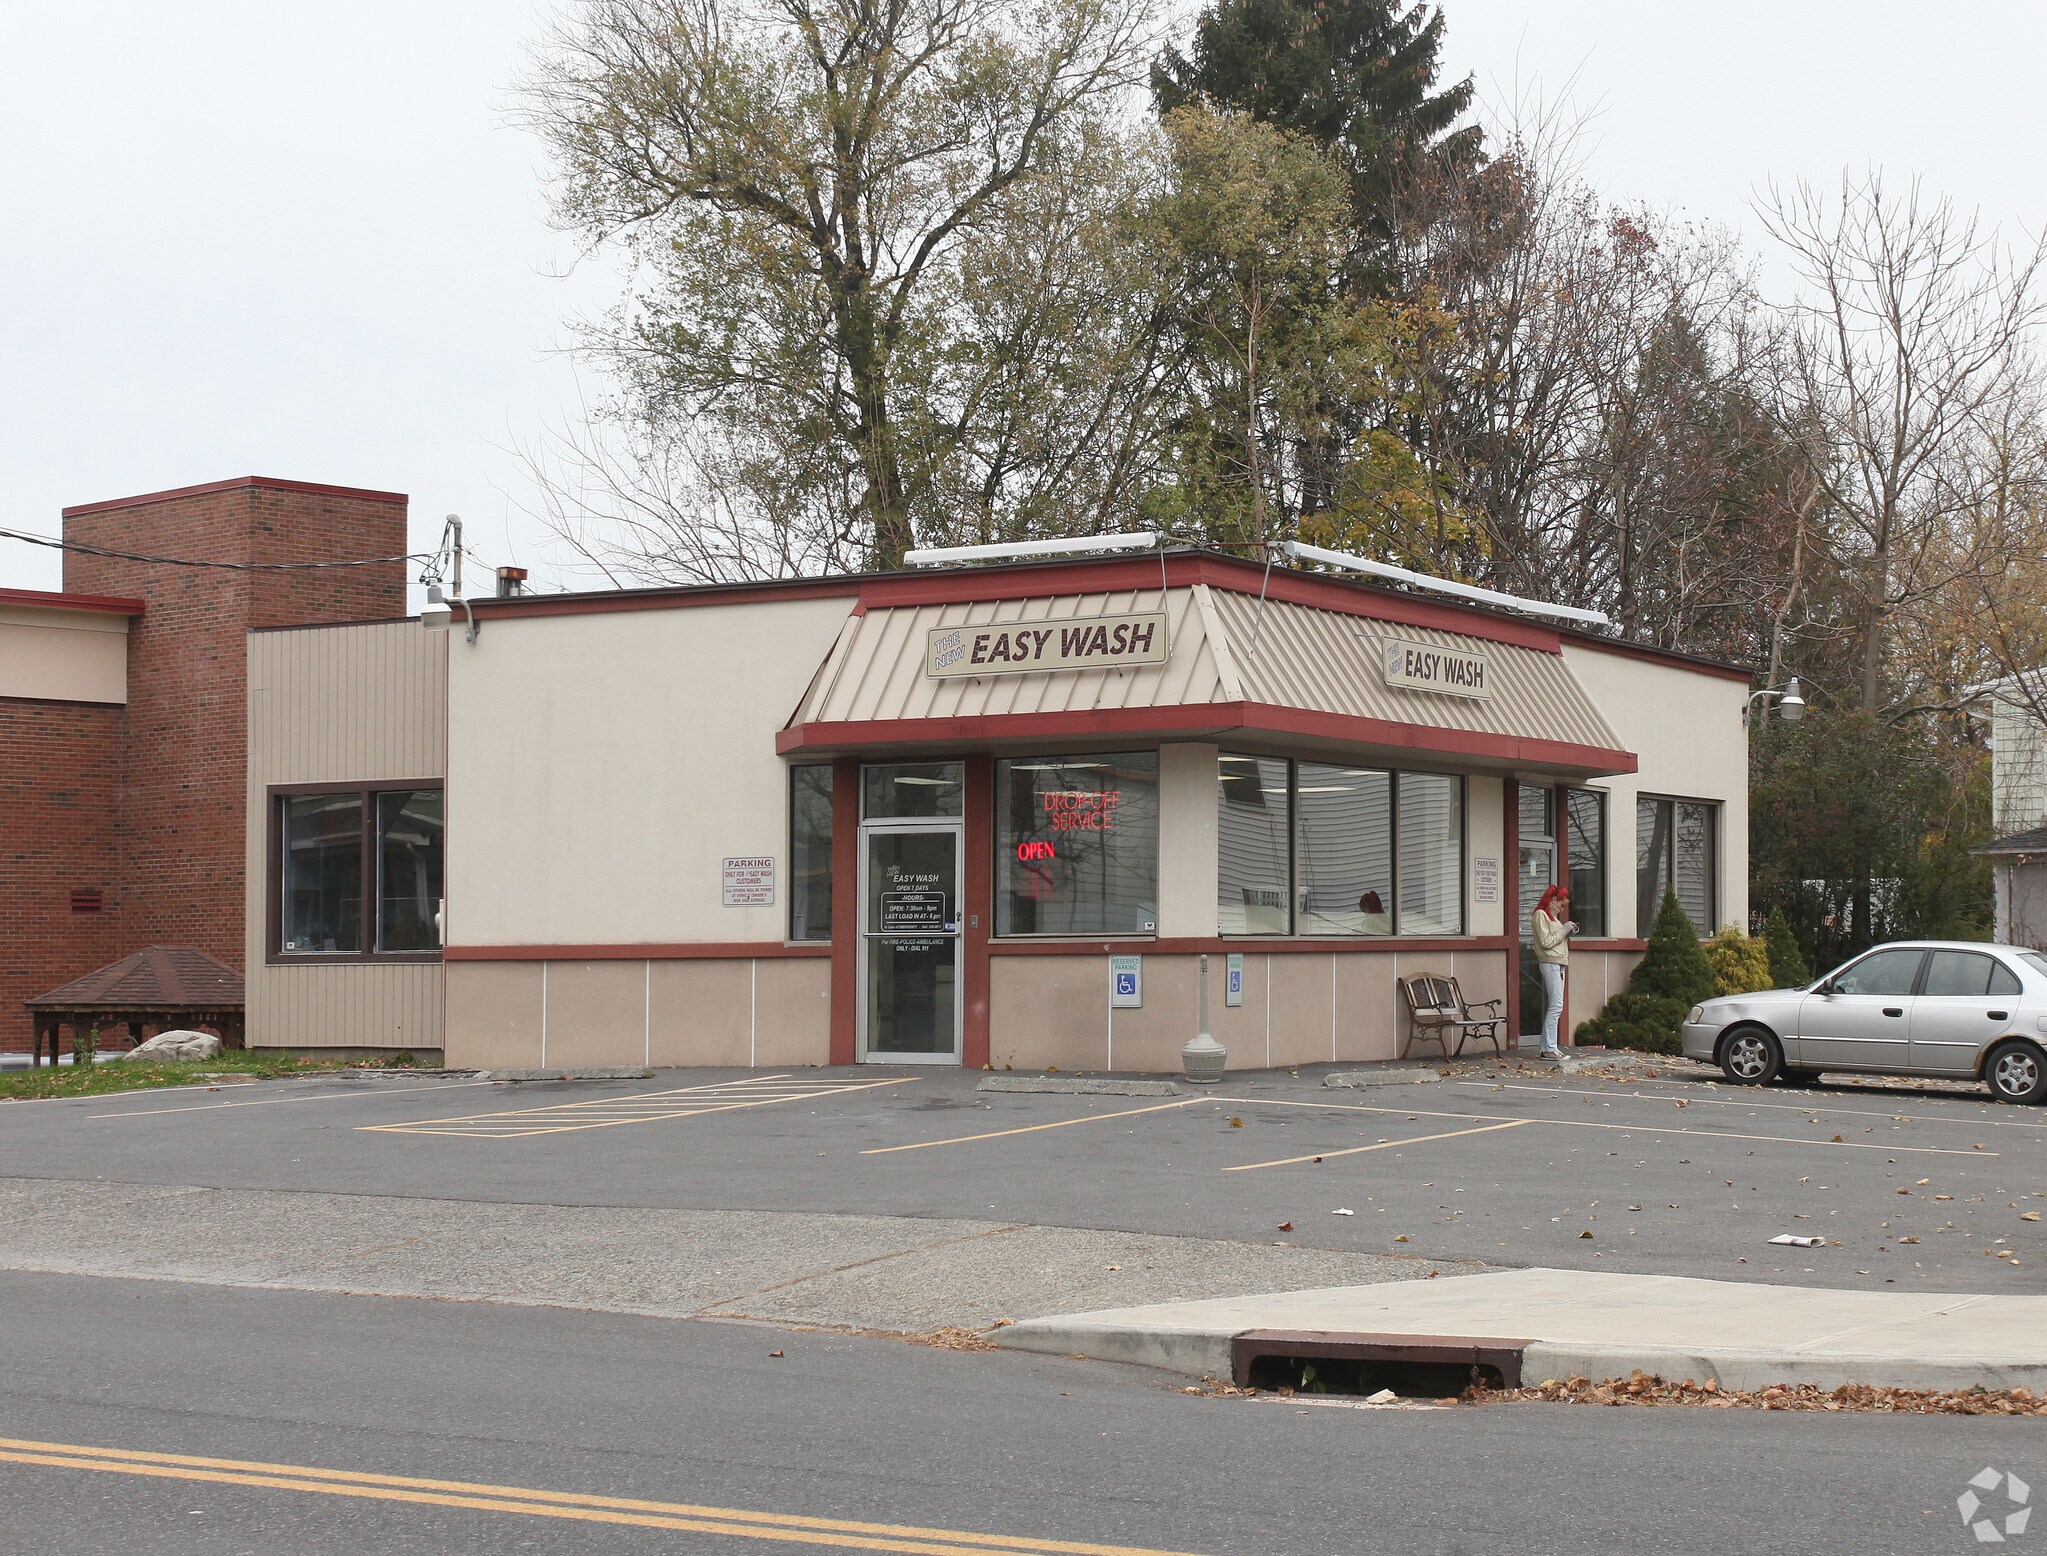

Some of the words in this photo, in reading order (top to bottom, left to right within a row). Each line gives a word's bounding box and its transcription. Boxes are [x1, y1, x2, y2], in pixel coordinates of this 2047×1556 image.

[934, 631, 961, 653] THE
[970, 629, 1054, 665] EASY
[1061, 622, 1155, 657] WASH
[935, 645, 966, 670] NEW
[1405, 649, 1441, 681] EASY
[1444, 656, 1483, 688] WASH
[1051, 811, 1114, 830] SERVICE
[1017, 841, 1056, 861] OPEN
[728, 859, 771, 867] PARKING
[893, 874, 915, 883] EASY
[915, 874, 939, 882] WASH
